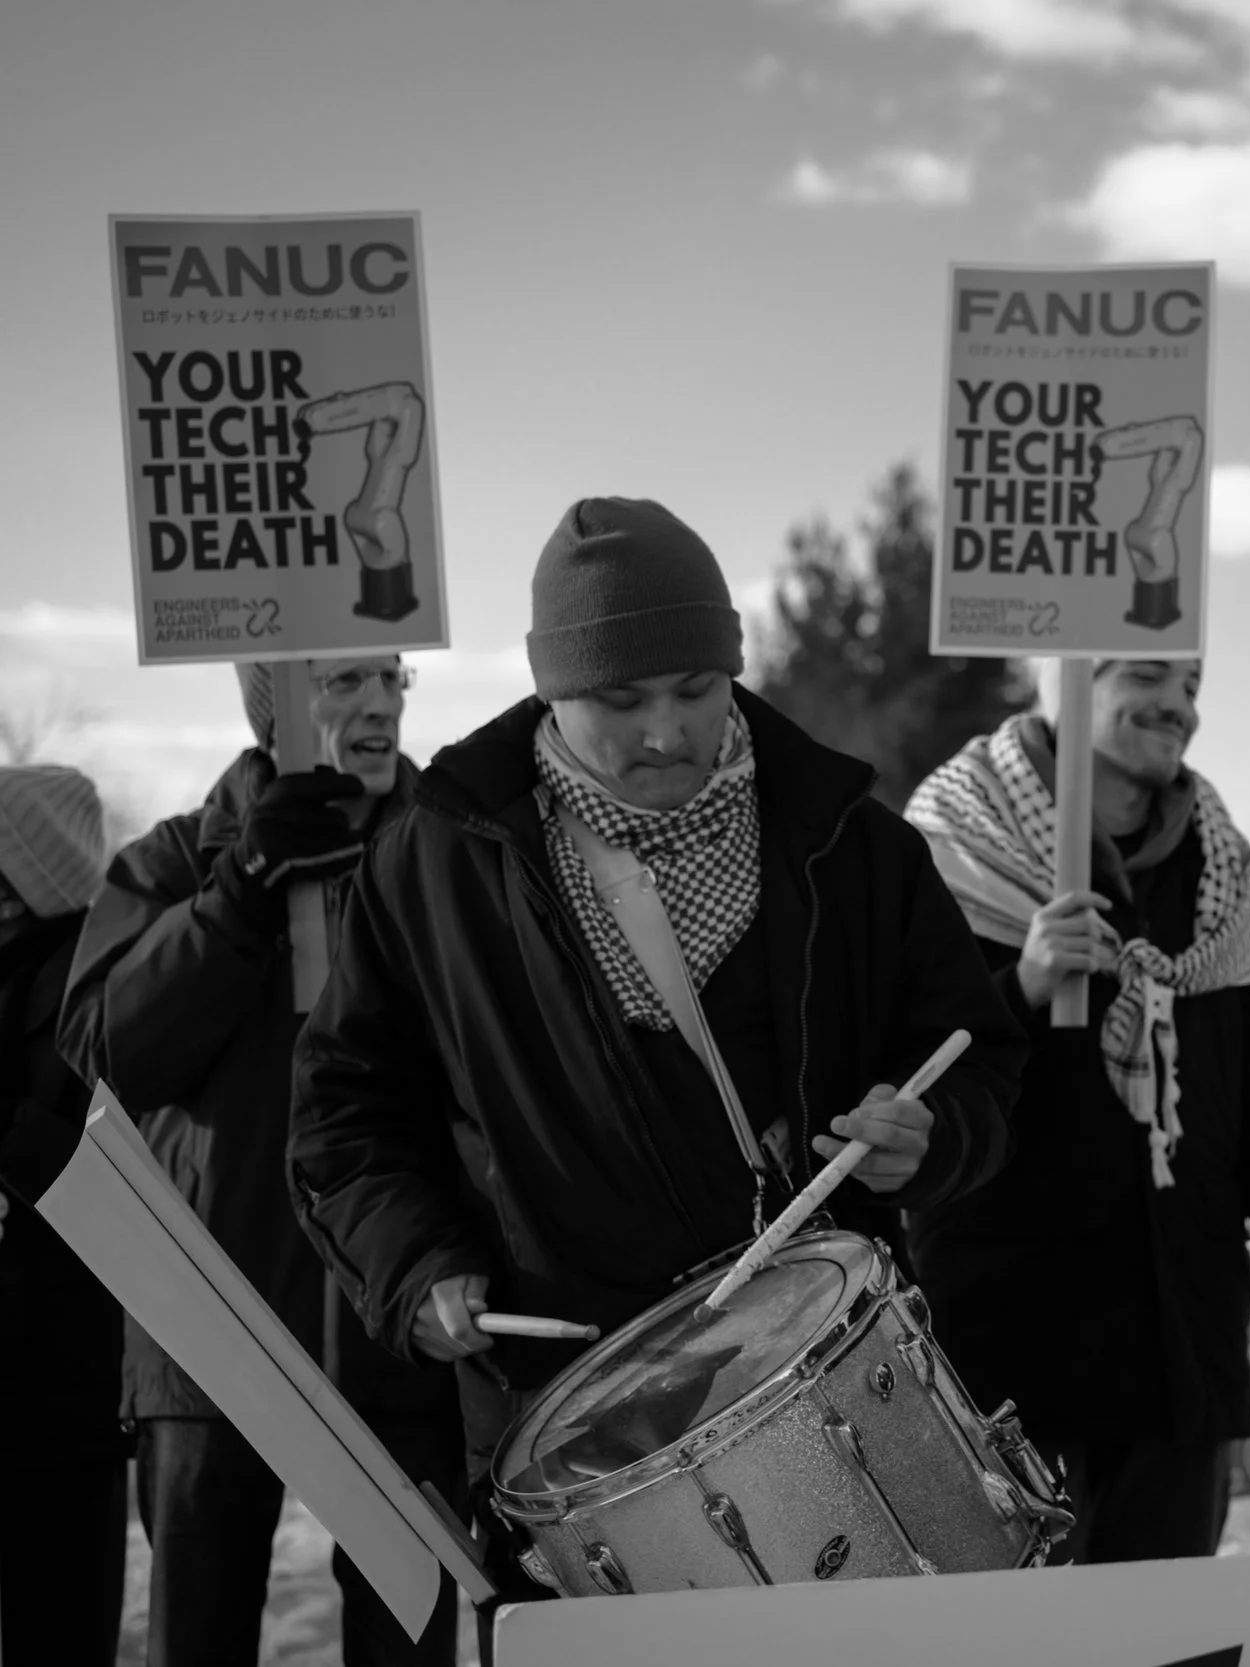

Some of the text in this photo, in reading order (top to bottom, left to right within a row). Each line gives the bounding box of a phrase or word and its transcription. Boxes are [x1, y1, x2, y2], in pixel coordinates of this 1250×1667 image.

[124, 242, 410, 298] FANUC
[957, 288, 1204, 337] FANUC
[132, 349, 309, 402] YOUR
[956, 379, 1105, 428] YOUR
[142, 461, 316, 515] THEIR
[952, 478, 1101, 526] THEIR
[148, 515, 340, 572] DEATH
[951, 526, 1118, 576] DEATH
